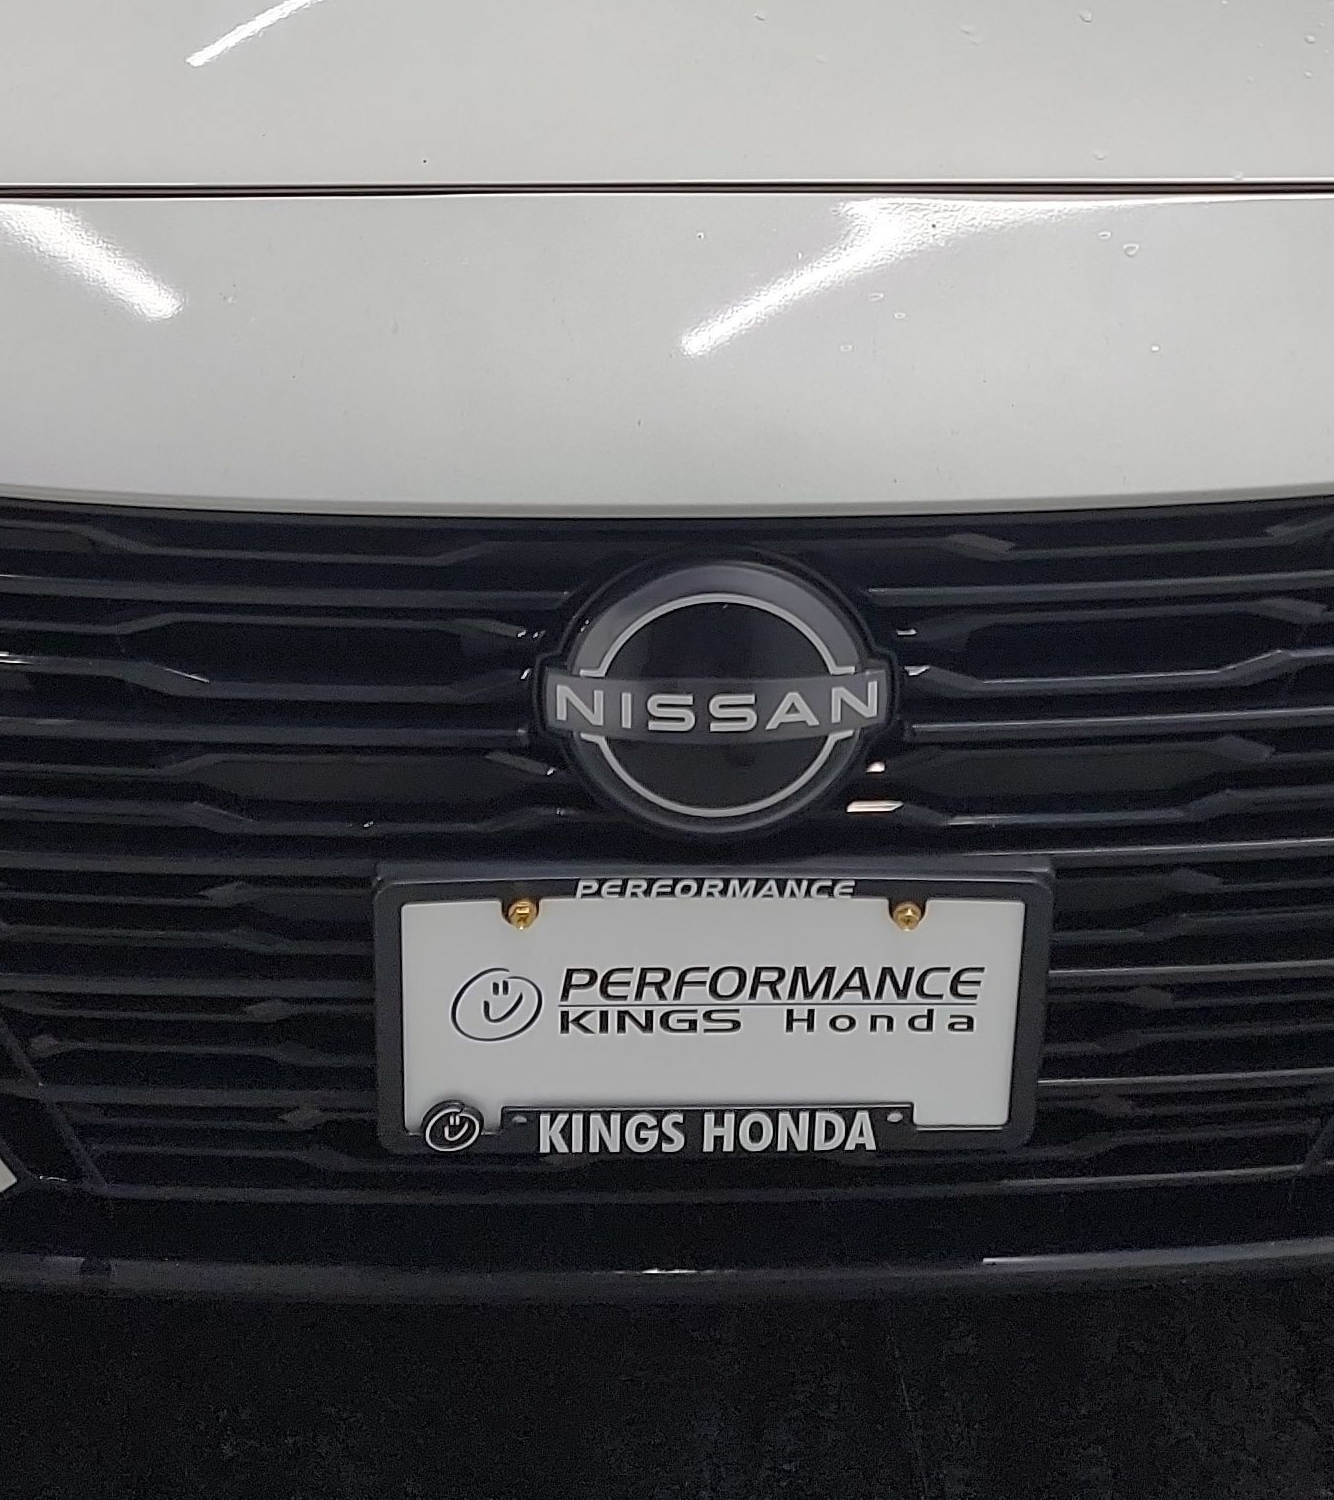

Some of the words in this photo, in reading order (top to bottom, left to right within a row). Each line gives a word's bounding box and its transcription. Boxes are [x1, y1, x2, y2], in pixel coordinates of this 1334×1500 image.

[556, 680, 878, 732] NISSAN
[575, 879, 856, 899] PERFORMANCE
[560, 967, 986, 1002] PERFORMANCE
[560, 1009, 742, 1034] KINGS
[785, 1008, 975, 1033] Honda
[538, 1112, 685, 1153] KINGS
[703, 1111, 877, 1152] HONDA
